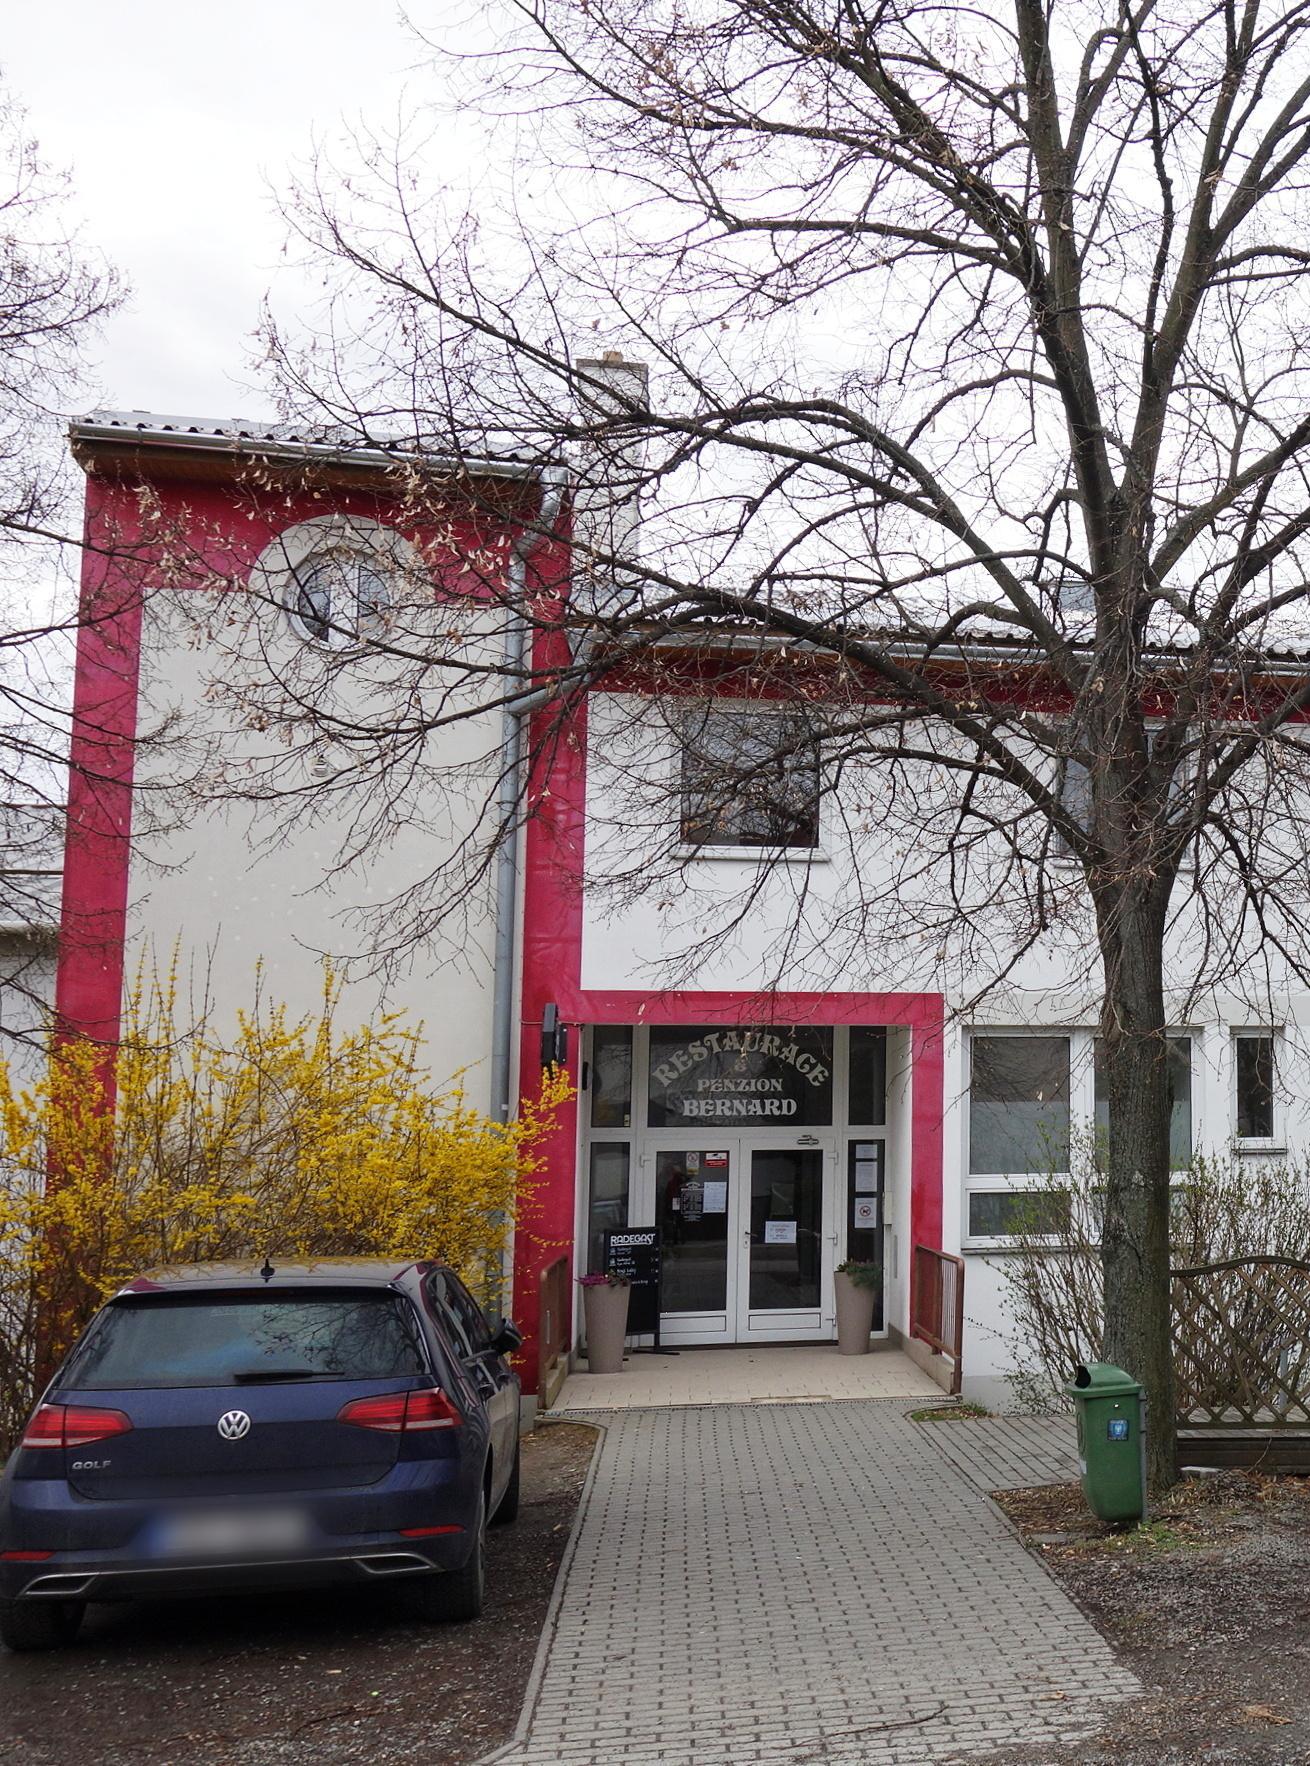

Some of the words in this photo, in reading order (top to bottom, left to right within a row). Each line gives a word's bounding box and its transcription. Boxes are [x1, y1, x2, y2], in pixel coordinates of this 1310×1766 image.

[652, 1031, 829, 1087] RESTAURACE
[697, 1078, 783, 1092] PENZION
[682, 1098, 797, 1117] BERNARD
[611, 1234, 656, 1246] RADEGAST
[72, 1460, 112, 1470] GOLF
